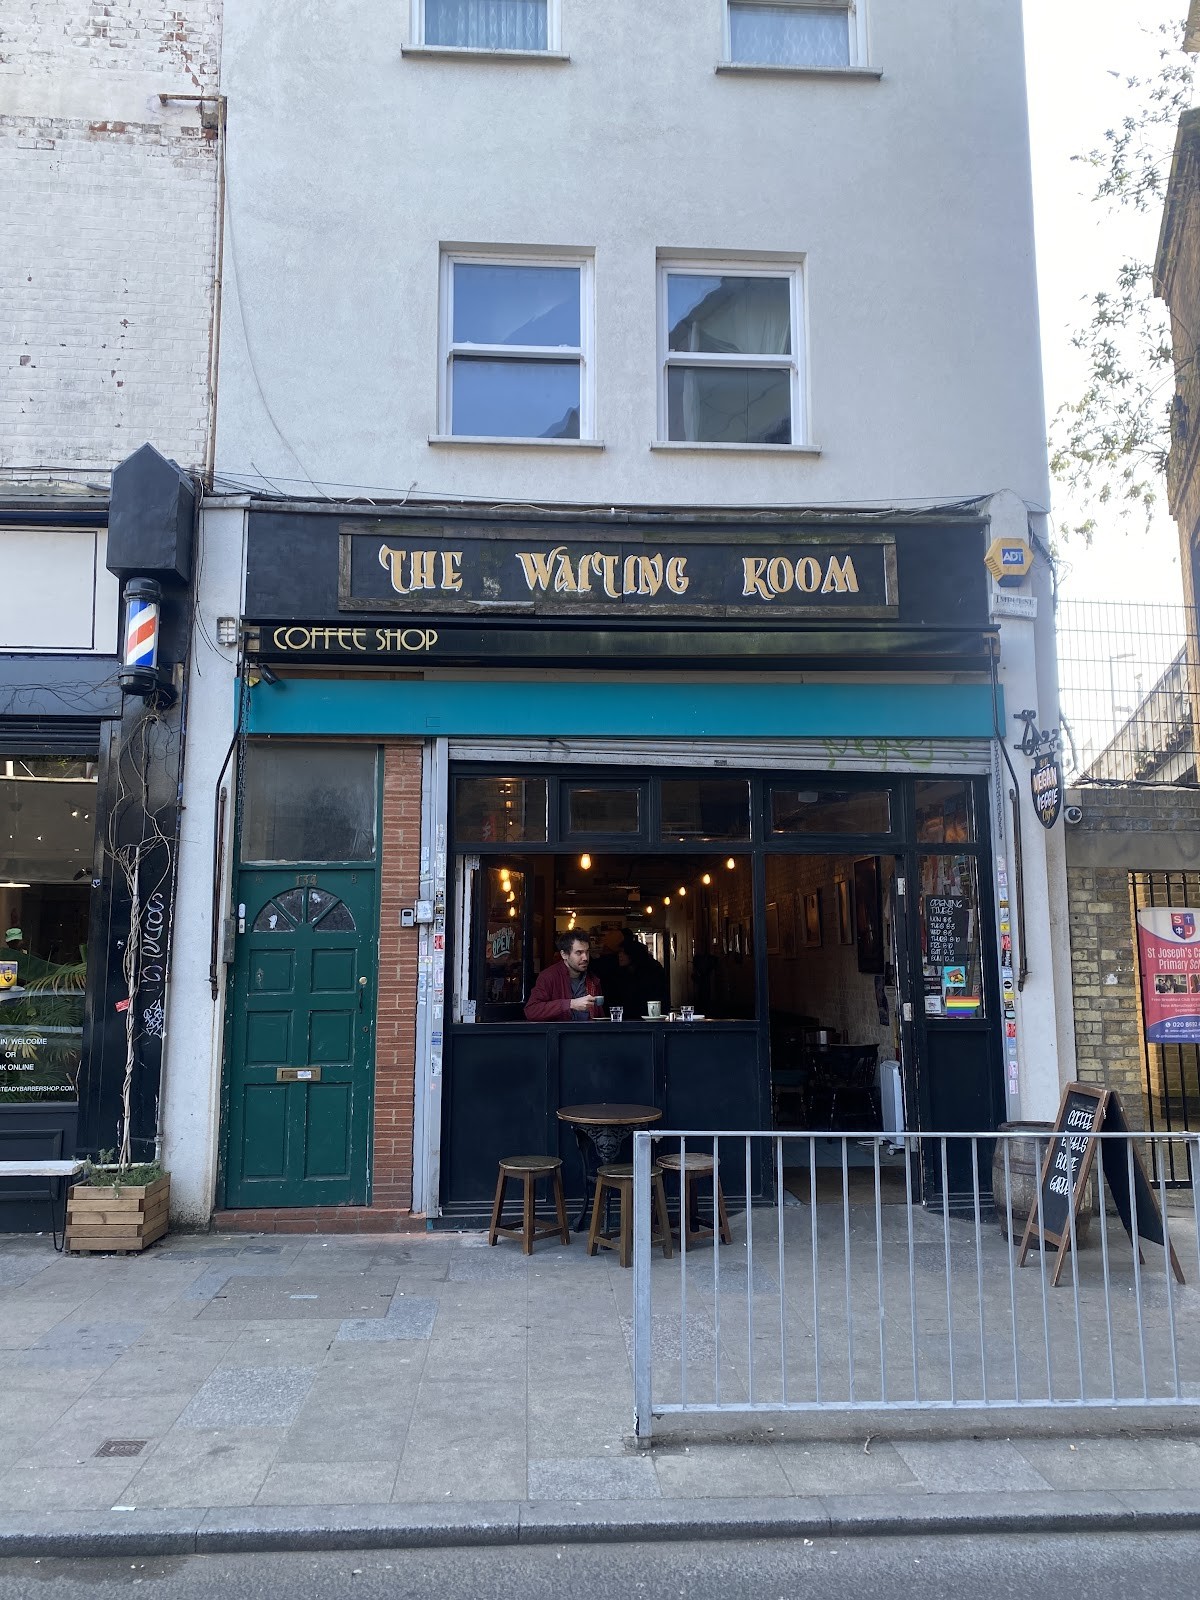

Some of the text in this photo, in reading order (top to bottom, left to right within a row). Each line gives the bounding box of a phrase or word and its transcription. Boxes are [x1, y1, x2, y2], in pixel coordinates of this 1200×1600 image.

[1003, 551, 1024, 562] ADT
[378, 544, 860, 601] THE WAITING ROOM
[273, 626, 438, 651] COFFEE SHOP
[1032, 766, 1058, 794] VEGAN
[1147, 948, 1156, 958] St
[1158, 947, 1193, 959] Joseph's
[1159, 959, 1189, 970] Primary
[1068, 1110, 1095, 1130] COFFEE
